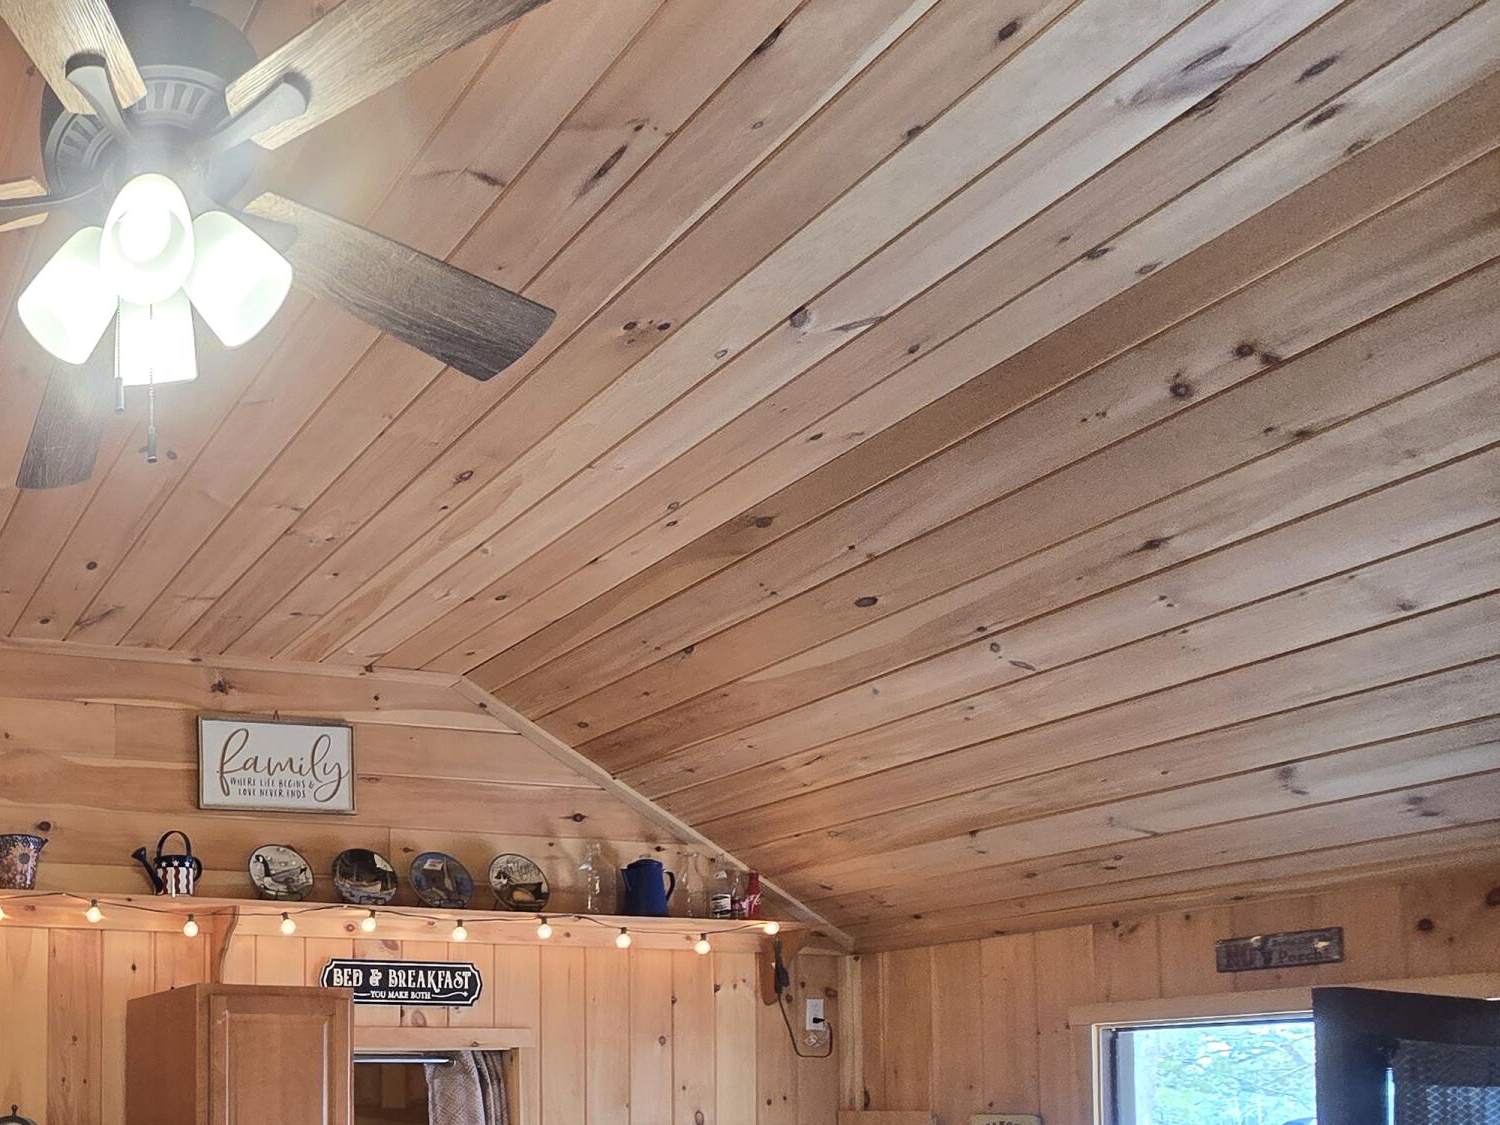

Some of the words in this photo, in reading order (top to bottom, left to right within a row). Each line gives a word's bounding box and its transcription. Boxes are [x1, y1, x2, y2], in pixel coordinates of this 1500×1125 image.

[216, 728, 350, 802] family
[230, 777, 256, 787] WHERE
[260, 778, 274, 788] LIFE
[278, 779, 306, 789] BEGINS
[238, 787, 256, 797] LOVE
[259, 788, 284, 798] NEVER
[287, 789, 306, 799] ENDS
[333, 968, 363, 987] BED
[369, 969, 383, 987] &
[388, 969, 472, 993] BREAKFAST
[370, 990, 386, 999] YOU
[387, 990, 409, 999] MAKE
[410, 991, 431, 1000] BOTH
